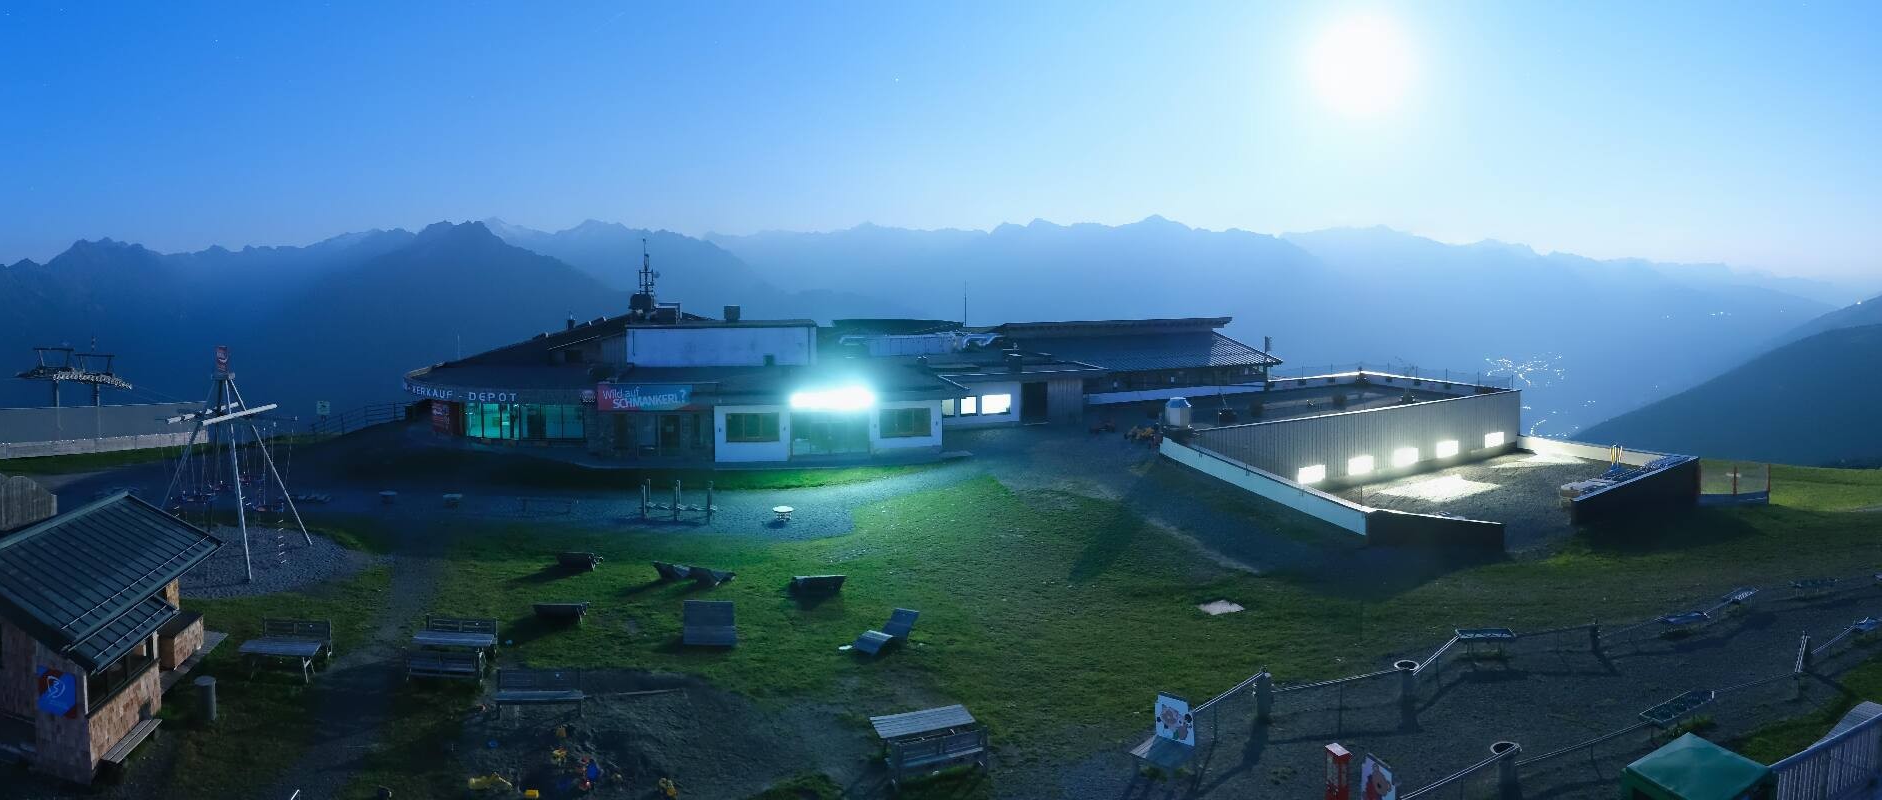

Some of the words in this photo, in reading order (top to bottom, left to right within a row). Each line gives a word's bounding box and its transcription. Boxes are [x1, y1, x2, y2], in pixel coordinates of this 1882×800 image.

[468, 391, 517, 402] DEPOT
[603, 388, 623, 399] Wild
[625, 386, 640, 397] auf
